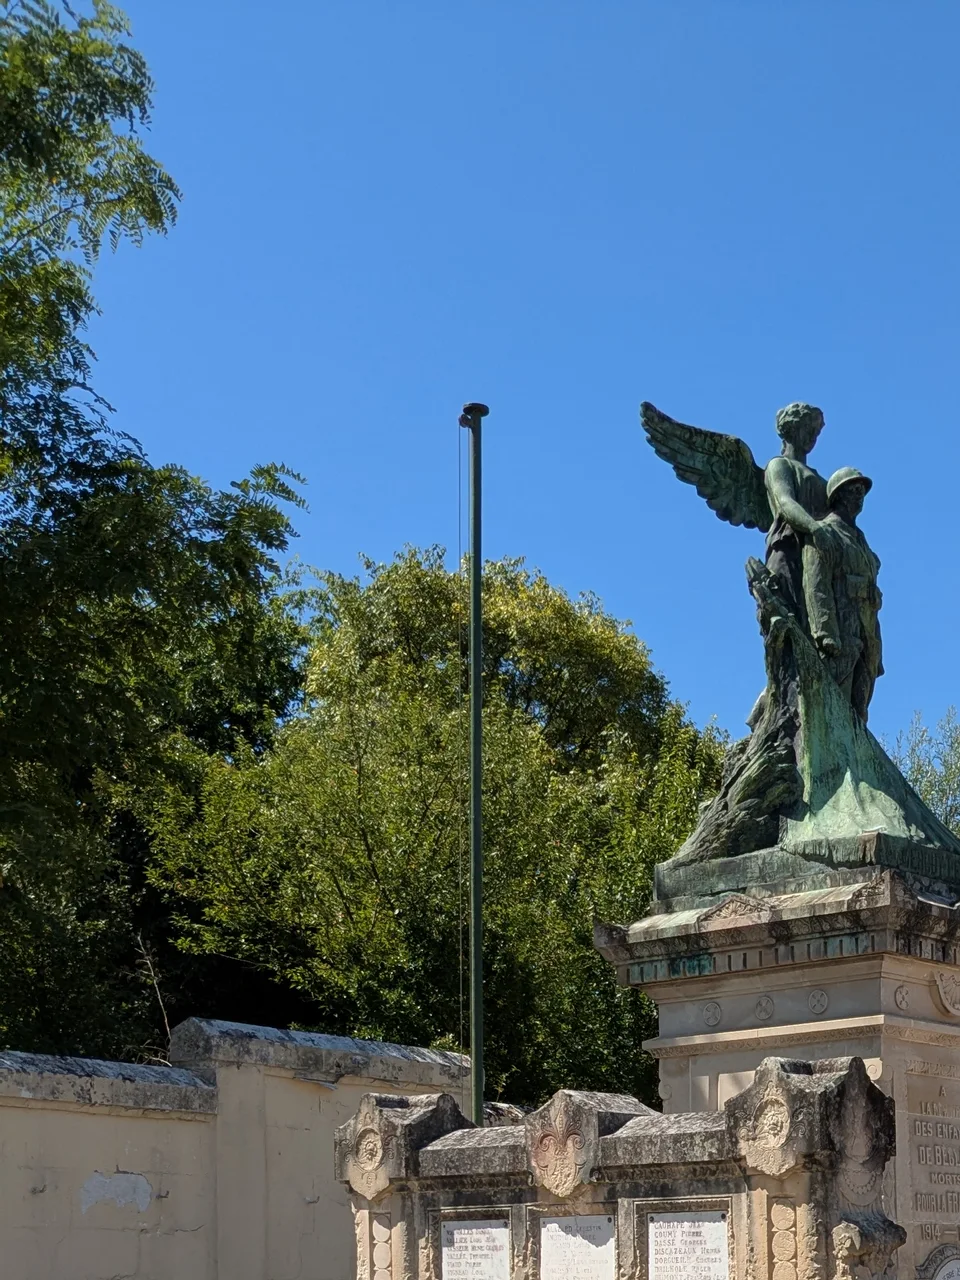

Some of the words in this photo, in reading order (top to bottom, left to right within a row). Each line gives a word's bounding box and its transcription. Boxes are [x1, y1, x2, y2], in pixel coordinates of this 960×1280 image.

[920, 1101, 932, 1115] LA
[915, 1120, 933, 1137] DES
[918, 1145, 931, 1165] DE
[915, 1193, 935, 1213] POUR
[936, 1194, 947, 1213] LA
[920, 1223, 941, 1241] 1914
